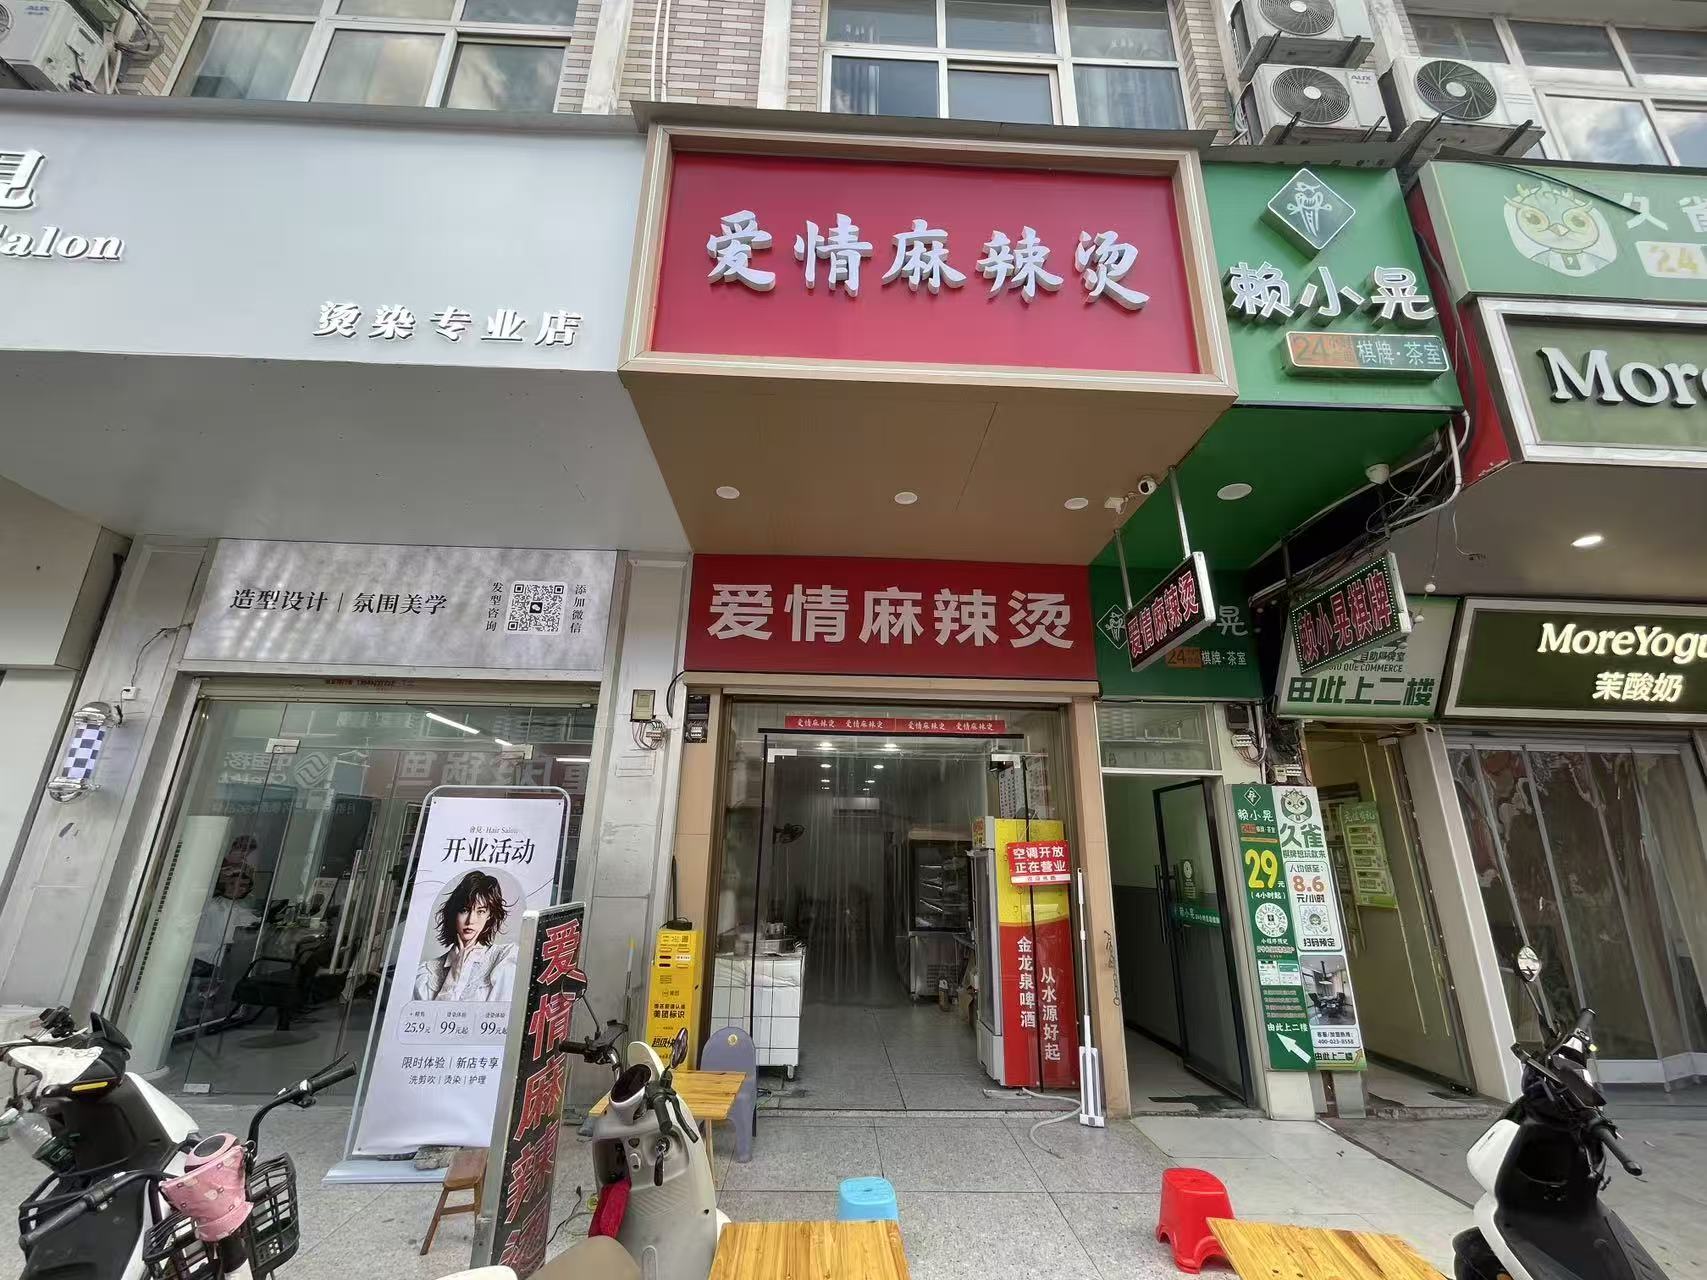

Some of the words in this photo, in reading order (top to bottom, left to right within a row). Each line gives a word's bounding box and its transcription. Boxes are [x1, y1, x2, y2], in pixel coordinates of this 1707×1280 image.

[706, 209, 1150, 311] 爱情麻辣烫
[1227, 261, 1438, 323] 赖小晃
[312, 300, 584, 347] 烫染专业店
[1536, 346, 1707, 408] Mor
[230, 589, 328, 613] 造型设计
[351, 592, 448, 616] 氛围美学
[485, 581, 504, 632] 发型咨询
[570, 583, 588, 634] 添加微信
[706, 583, 1075, 649] 爱情麻辣烫
[1126, 570, 1199, 659] 爱情麻辣烫
[1298, 568, 1393, 665] 赖小晃棋牌
[1201, 650, 1248, 666] 棋牌·茶室
[1360, 663, 1404, 673] COMMERCE
[1287, 674, 1435, 706] 由此上二楼
[1591, 671, 1684, 703] 茉酸奶
[1237, 808, 1275, 822] 赖小晃
[1280, 823, 1325, 848] 久雀
[440, 837, 536, 865] 开业活动
[1013, 846, 1065, 859] 空调开放
[1015, 860, 1067, 873] 正在营业
[1292, 875, 1325, 893] 8.6
[1296, 893, 1325, 903] 元/小时
[1303, 937, 1336, 948] 扫码预定
[1016, 936, 1037, 1029] 金龙泉啤酒
[404, 1021, 431, 1034] 25.9元
[440, 1021, 470, 1035] 99元起
[1040, 967, 1061, 1062] 从水源好起
[1266, 1022, 1309, 1033] 由此上二楼
[400, 1056, 446, 1069] 限时体验
[456, 1056, 500, 1069] 新店专享
[1314, 1051, 1354, 1062] 由此上二楼
[408, 1074, 436, 1085] 洗剪吹
[443, 1074, 462, 1085] 烫染
[468, 1074, 487, 1085] 护理
